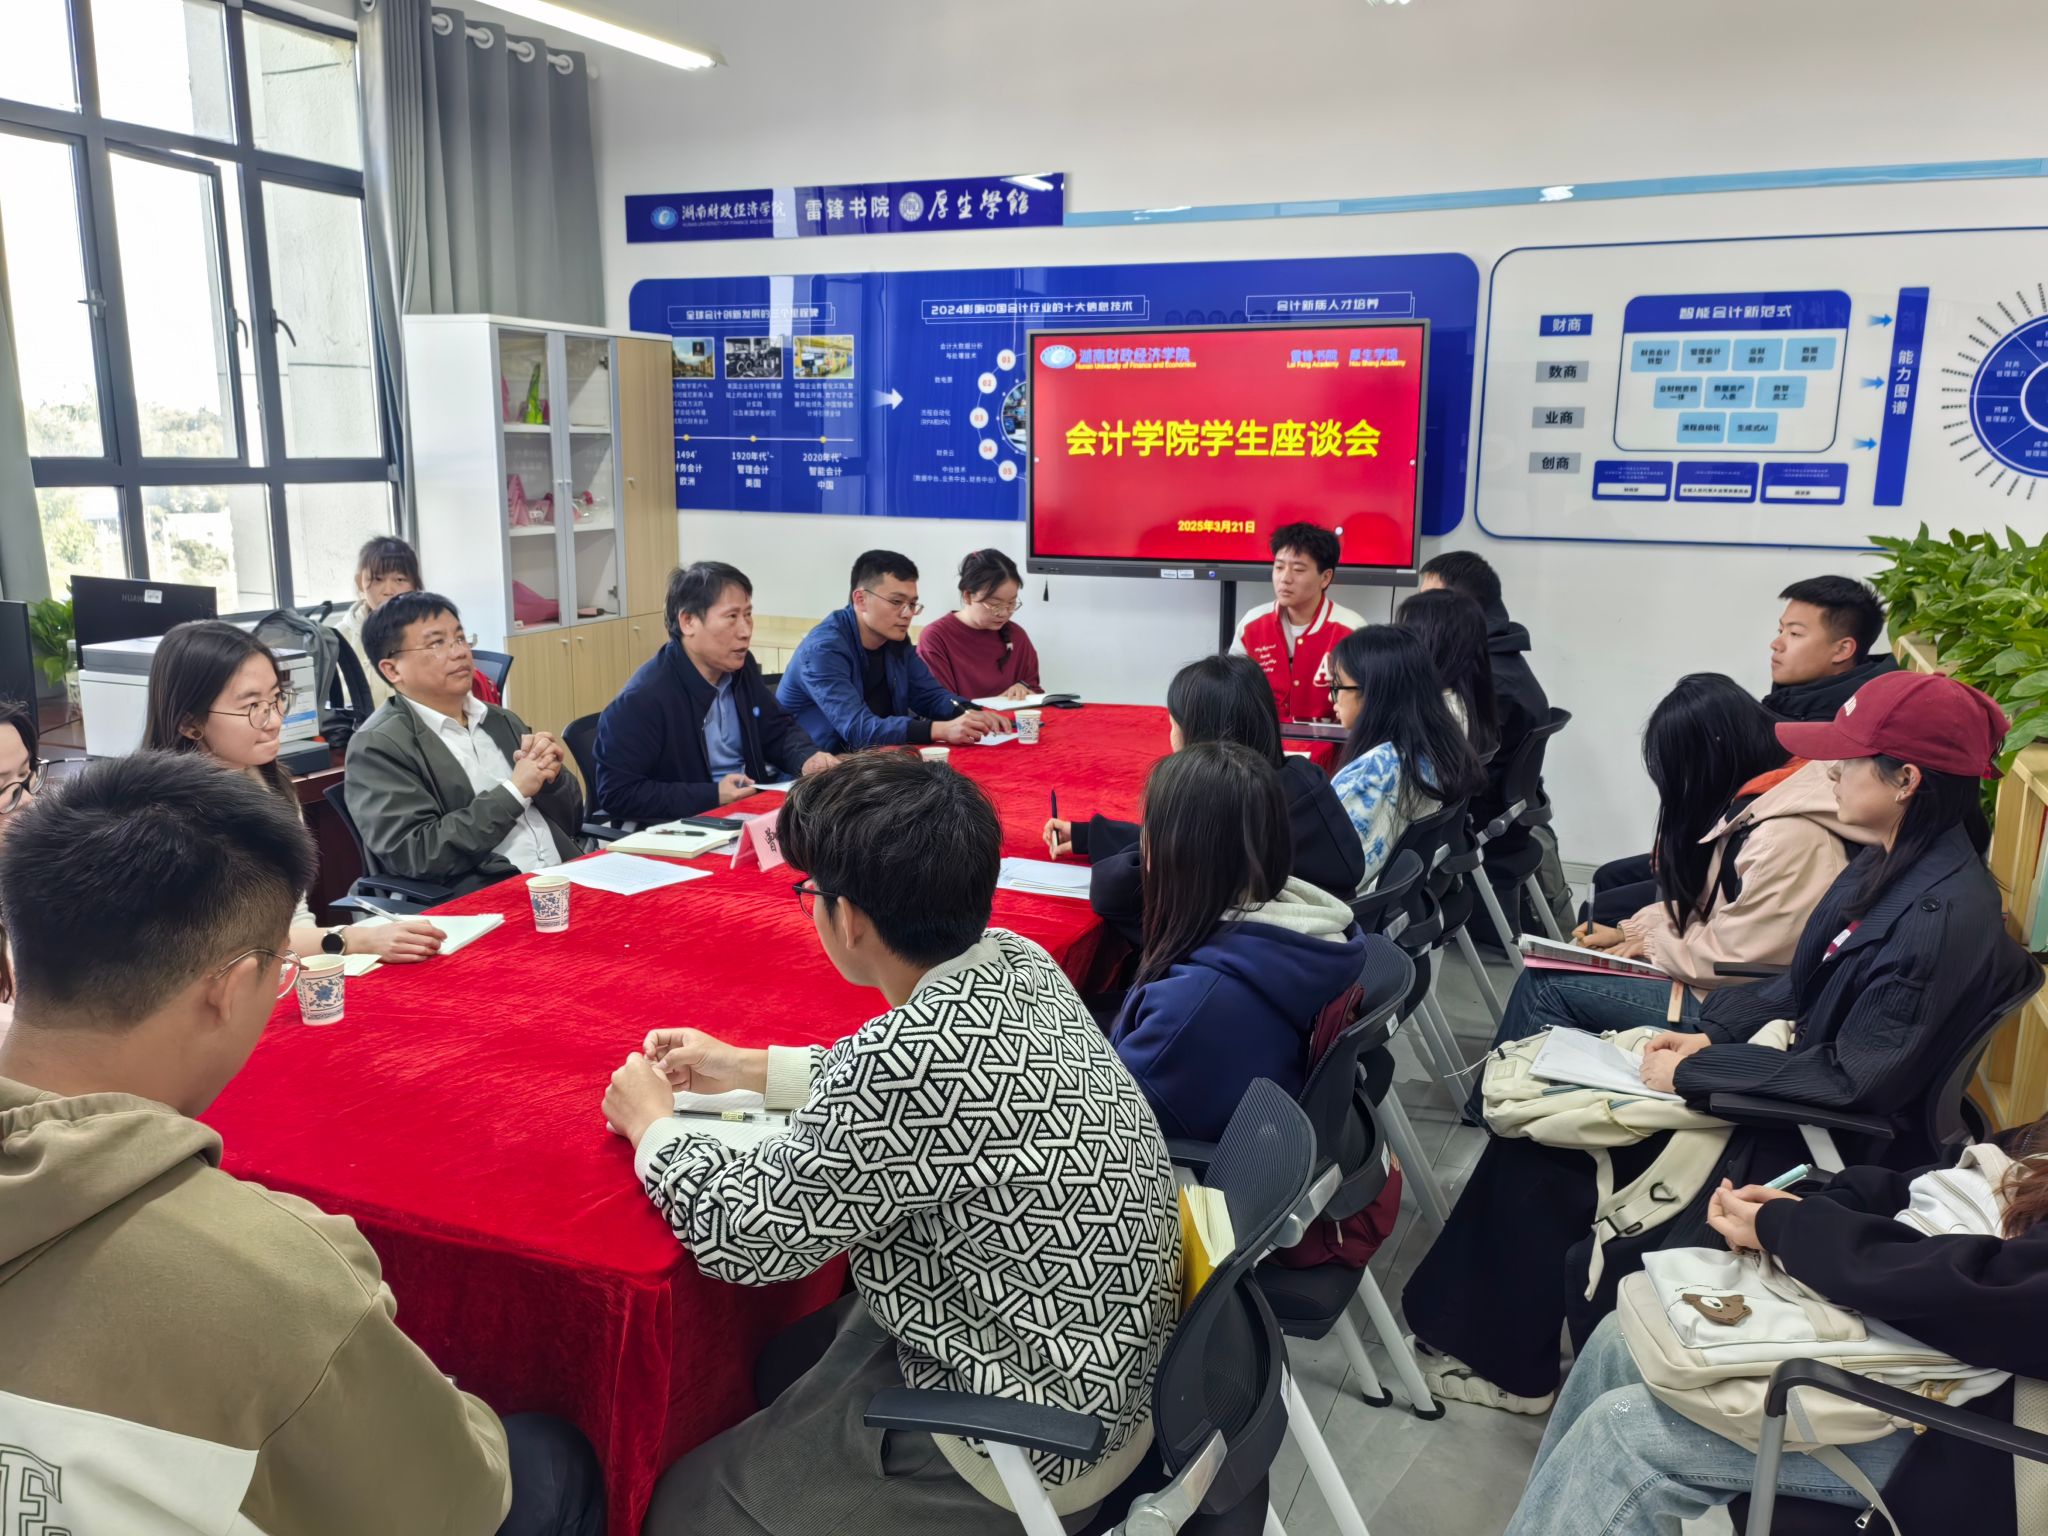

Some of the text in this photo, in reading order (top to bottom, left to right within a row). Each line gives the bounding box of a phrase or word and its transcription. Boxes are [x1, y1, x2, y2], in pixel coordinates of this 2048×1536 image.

[682, 200, 786, 220] 湖南财政经济学院
[805, 196, 890, 221] 雷锋书院
[931, 301, 1133, 315] 2024影响中国会计行业的十大信息技术
[1679, 304, 1792, 320] 智能会计新范式
[1552, 318, 1582, 332] 财商
[1080, 347, 1190, 363] 湖南财政经济学院
[1312, 360, 1339, 368] Academy
[1380, 359, 1406, 367] Academy
[1548, 365, 1577, 379] 数商
[982, 379, 992, 387] 02
[1892, 350, 1914, 415] 能力图谱
[1545, 411, 1573, 425] 业商
[1065, 418, 1381, 457] 会计学院学生座谈会
[737, 465, 769, 475] 管理会计
[1542, 456, 1570, 470] 创商
[809, 467, 842, 476] 智能会计
[1003, 467, 1012, 475] 05
[679, 477, 695, 486] 欧洲
[745, 479, 761, 488] 美国
[817, 480, 834, 490] 中国
[1178, 520, 1255, 533] 2025年3月21日
